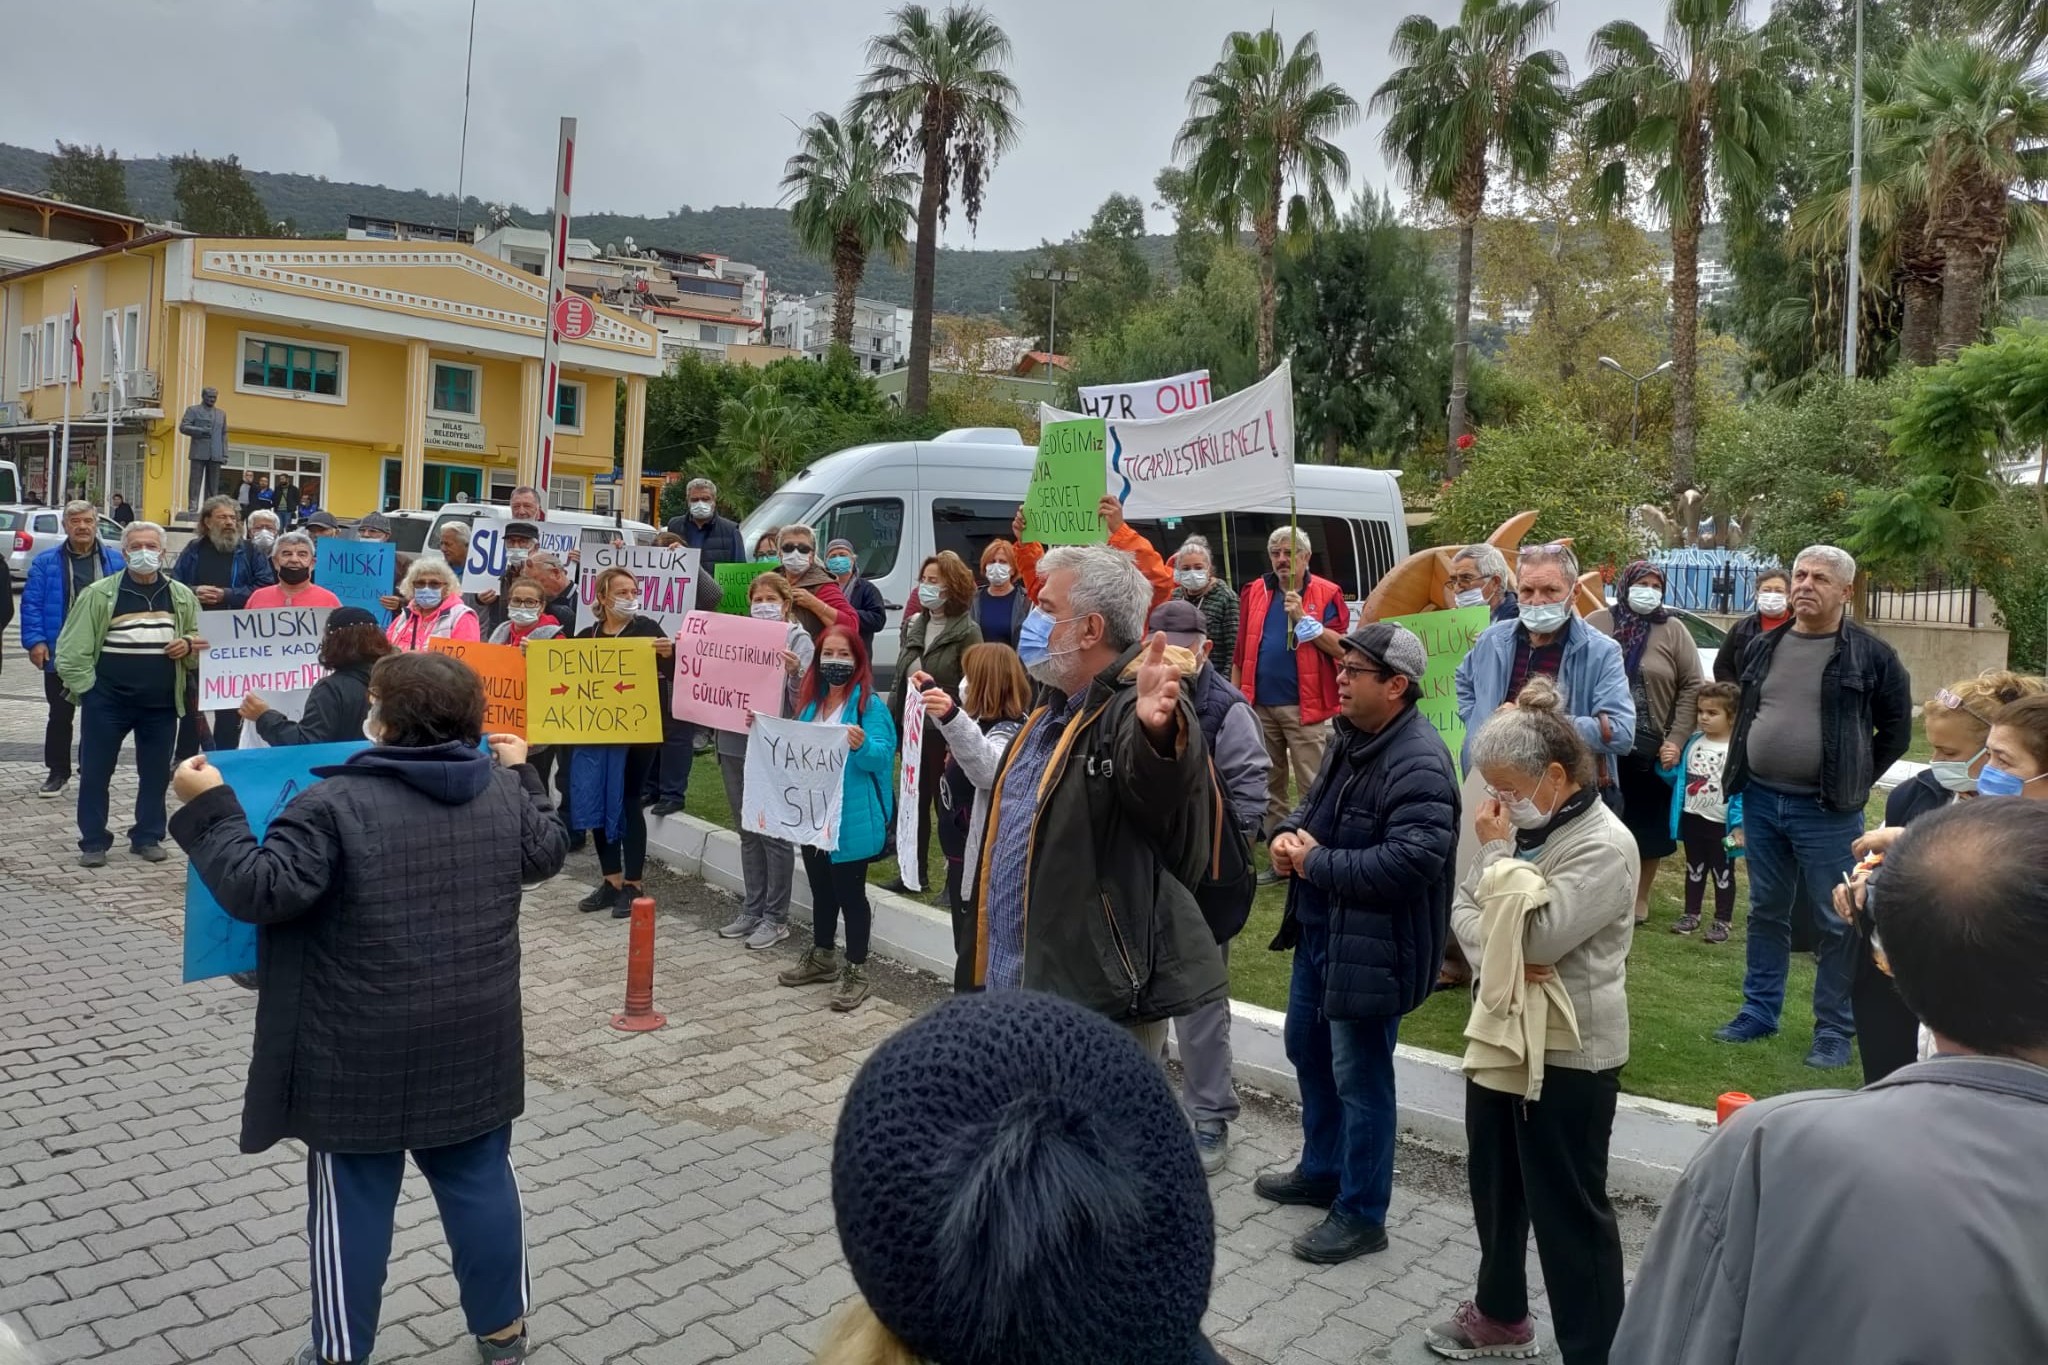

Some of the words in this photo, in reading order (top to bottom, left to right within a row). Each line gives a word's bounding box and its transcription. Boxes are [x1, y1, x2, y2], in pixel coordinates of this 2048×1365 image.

[566, 301, 584, 335] DUR
[1083, 393, 1136, 419] HZR
[1156, 378, 1211, 414] OUT
[1038, 486, 1080, 507] SERVET
[467, 529, 507, 577] SU
[541, 532, 577, 552] İZASYON
[328, 548, 385, 577] MUSKİ
[596, 547, 687, 573] GÜLLÜK
[233, 608, 318, 639] MUSKİ
[687, 617, 708, 635] TEK
[210, 645, 273, 660] GELENE
[282, 642, 323, 656] KADA
[549, 645, 636, 675] DENİZE
[681, 655, 702, 678] SU
[483, 676, 524, 701] MUZU
[578, 680, 604, 701] NE
[484, 703, 526, 728] ETME
[542, 704, 647, 732] AKIYOR?
[764, 736, 844, 772] YAKAN
[781, 786, 827, 831] SU
